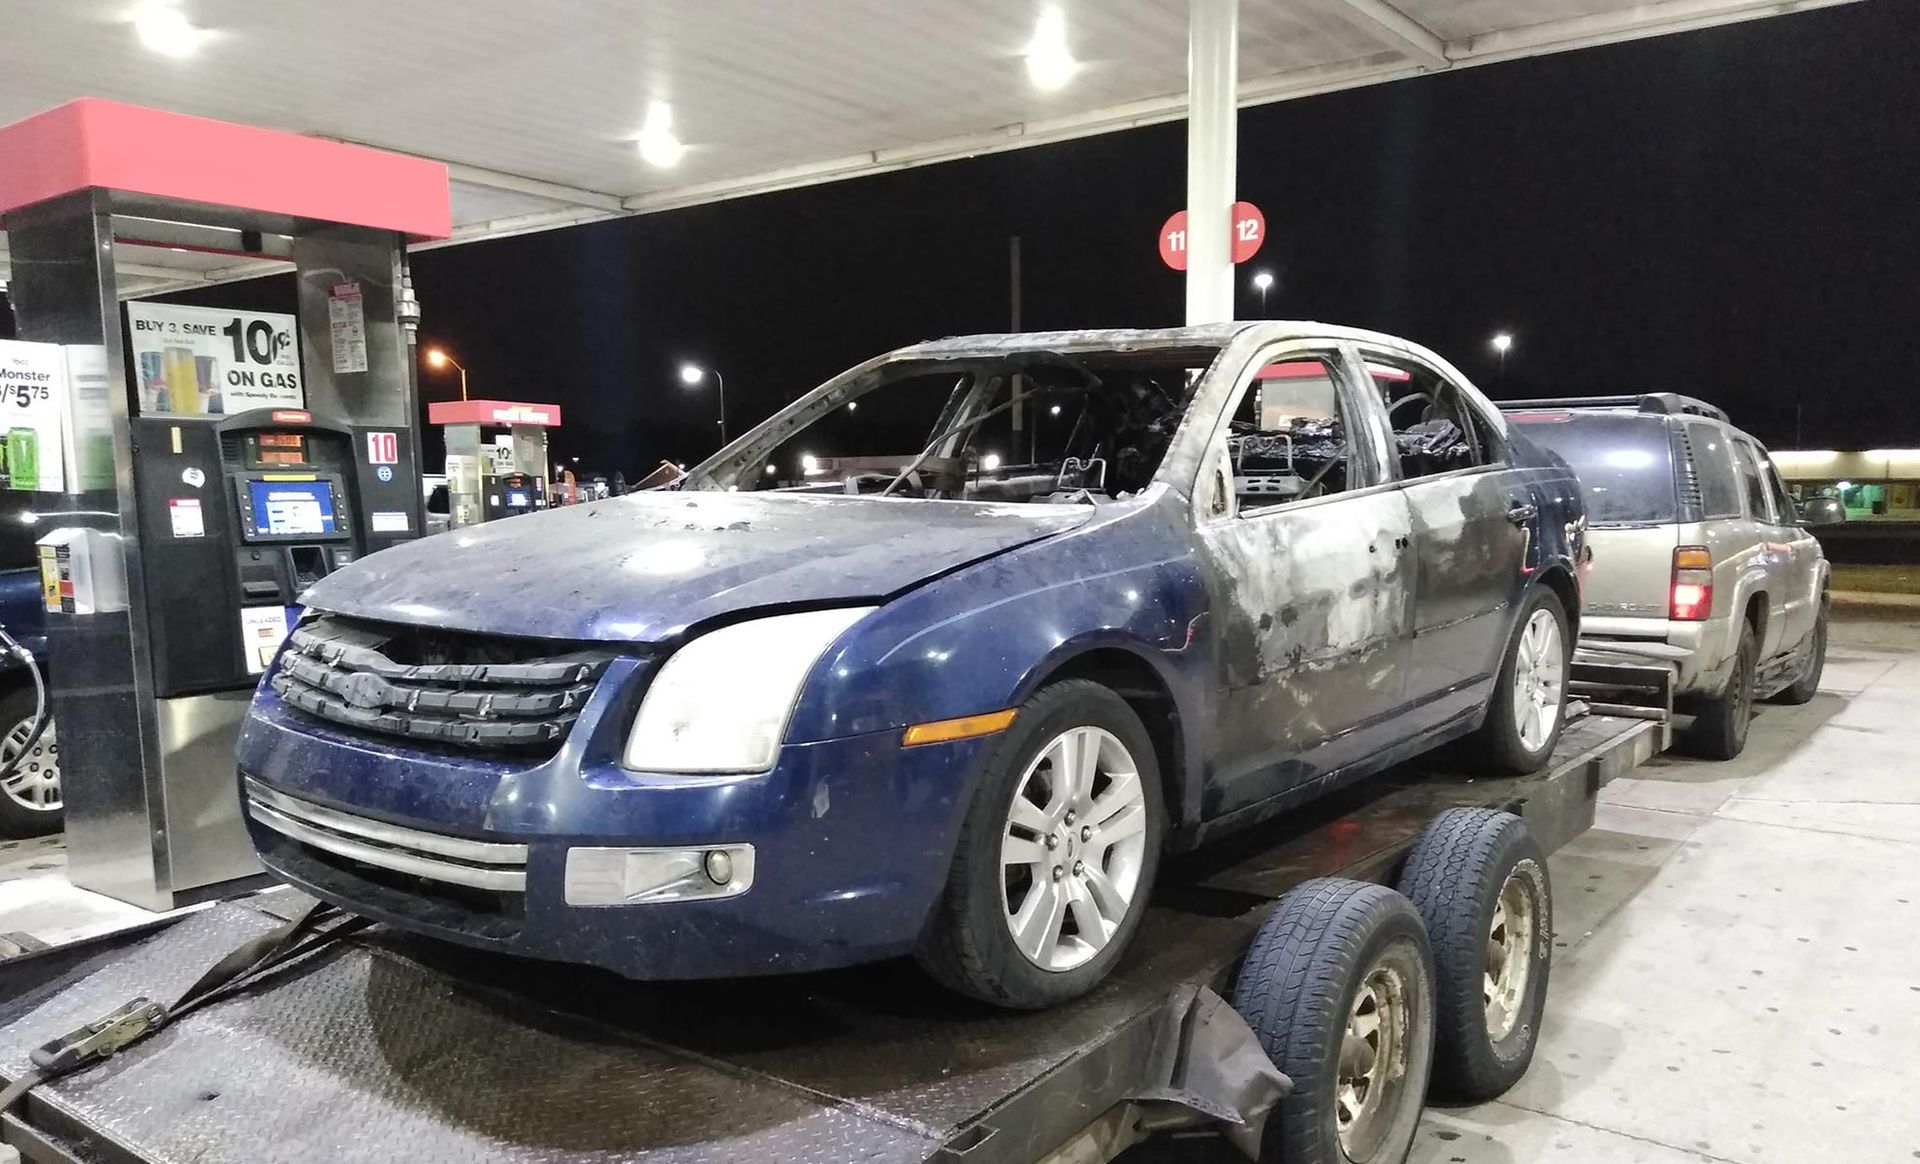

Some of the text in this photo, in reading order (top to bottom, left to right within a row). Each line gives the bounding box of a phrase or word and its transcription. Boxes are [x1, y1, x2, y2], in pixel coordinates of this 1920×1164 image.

[1236, 218, 1259, 241] 12
[1167, 230, 1185, 252] 11
[135, 319, 164, 332] BUY
[182, 323, 217, 336] SAVE
[227, 370, 297, 389] ON GAS
[371, 433, 397, 462] 10
